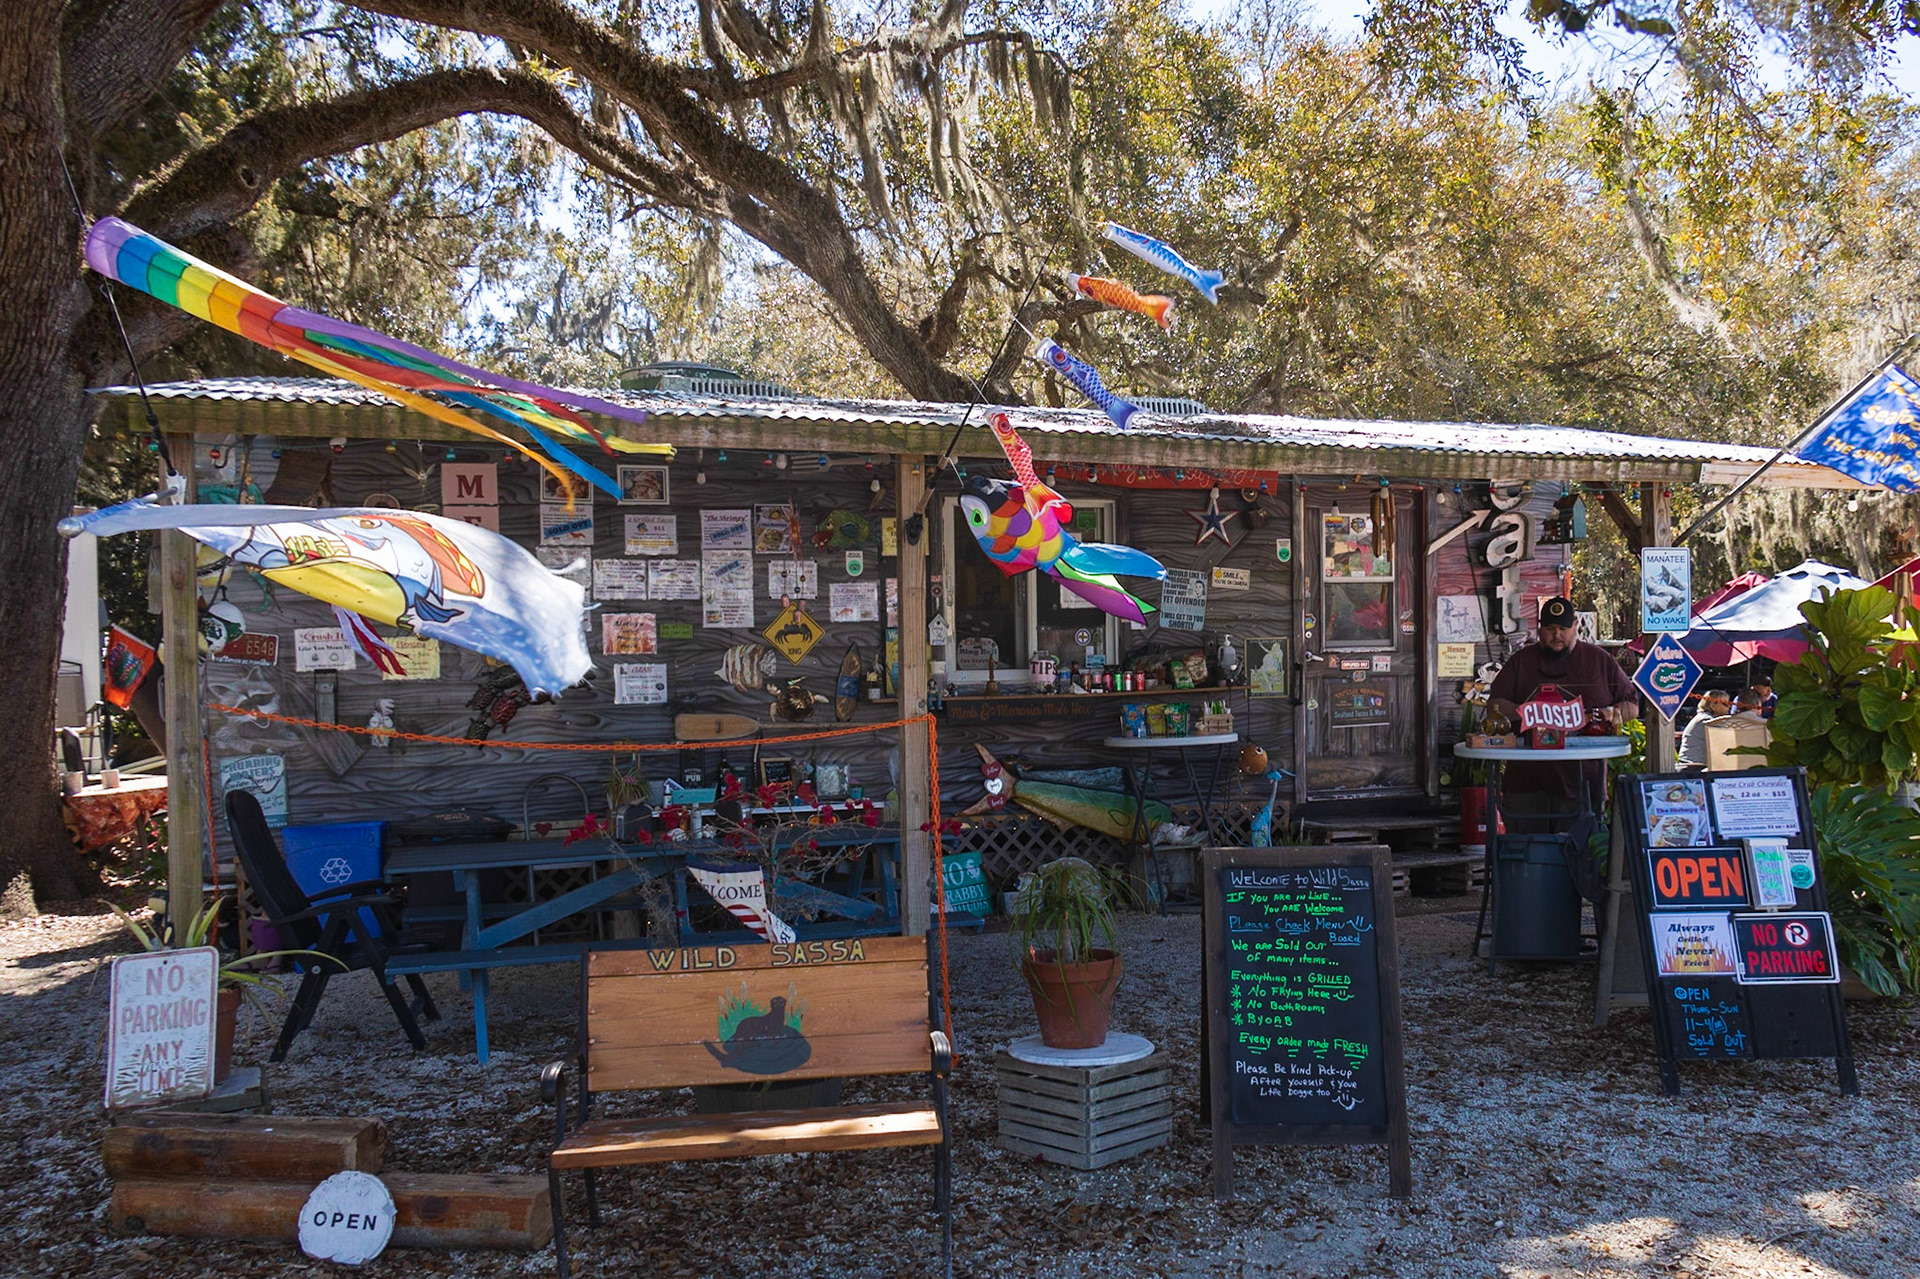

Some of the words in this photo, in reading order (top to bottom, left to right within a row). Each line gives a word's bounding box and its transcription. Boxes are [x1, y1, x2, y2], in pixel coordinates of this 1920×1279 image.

[456, 475, 484, 498] M
[572, 520, 588, 529] OUT
[1189, 571, 1200, 579] LIKE
[1223, 571, 1239, 579] SMILE
[1162, 595, 1174, 604] YET
[1174, 596, 1206, 607] OFFENDED
[1168, 619, 1195, 630] SHORTLY
[1648, 617, 1660, 625] NO
[1662, 616, 1687, 625] WAKE
[246, 640, 275, 656] 6548
[959, 648, 979, 656] Ring
[1030, 661, 1058, 676] TIPS
[1659, 694, 1680, 705] XING
[1524, 702, 1582, 729] CLOSED
[685, 774, 701, 782] PUB
[1717, 781, 1737, 789] Stone
[1739, 780, 1756, 788] Crab
[1758, 779, 1788, 788] Chowder
[1772, 790, 1787, 798] $15
[1294, 873, 1309, 885] to
[1309, 868, 1338, 886] Wild
[1656, 857, 1745, 898] OPEN
[945, 884, 985, 903] RABBY
[1668, 923, 1715, 934] Always
[1752, 923, 1777, 946] NO
[1231, 939, 1249, 951] We
[1275, 938, 1300, 950] Sold
[1676, 946, 1715, 956] Never
[647, 947, 737, 972] WILD
[771, 938, 866, 966] SASSA
[1747, 950, 1826, 973] PARKING
[146, 965, 184, 996] NO
[1308, 972, 1351, 985] GRILLED
[1248, 985, 1267, 997] No
[1674, 986, 1710, 1000] OPEN
[1247, 1000, 1262, 1009] No
[120, 998, 207, 1035] PARKING
[140, 1040, 184, 1061] ANY
[1334, 1038, 1369, 1055] FRESH
[1236, 1060, 1268, 1075] Please
[1274, 1063, 1287, 1074] Be
[138, 1067, 186, 1092] TIME
[1316, 1088, 1331, 1097] too
[313, 1211, 377, 1231] OPEN
